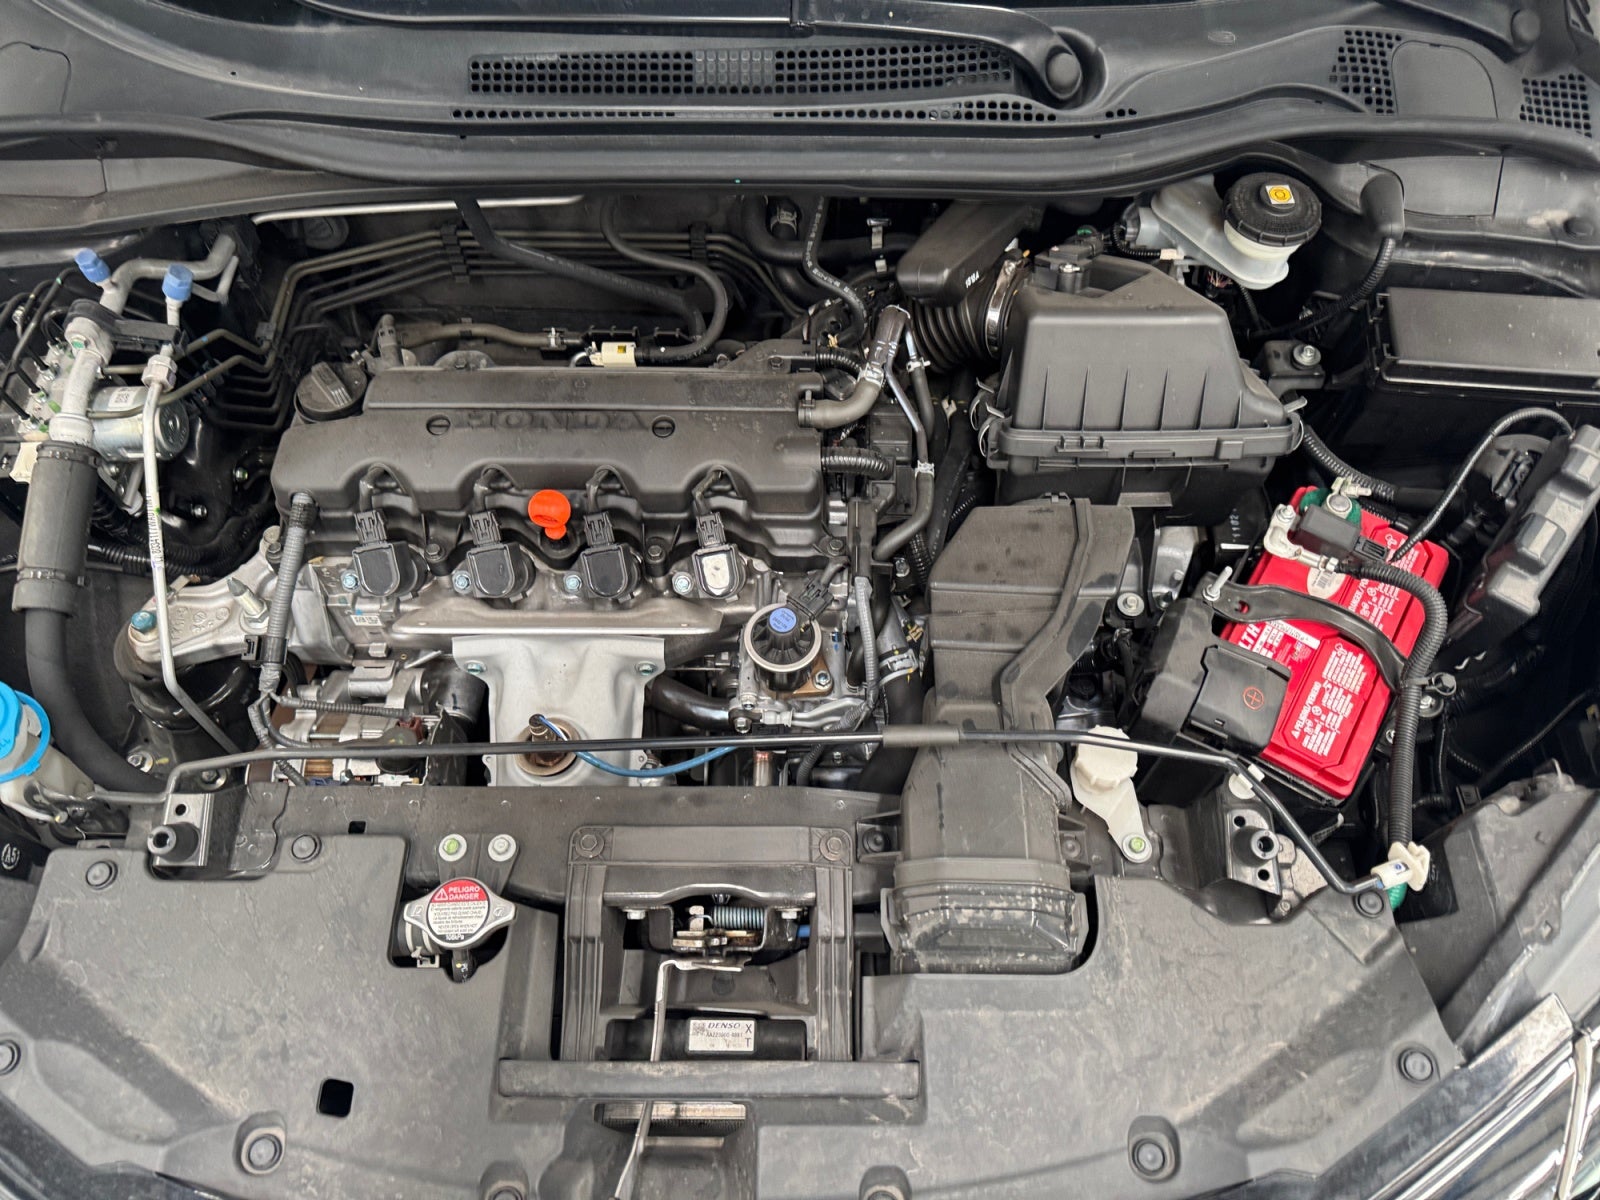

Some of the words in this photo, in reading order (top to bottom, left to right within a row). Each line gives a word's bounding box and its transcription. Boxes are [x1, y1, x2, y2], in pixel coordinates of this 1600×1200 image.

[453, 409, 649, 431] HONDA
[745, 1023, 752, 1034] X
[744, 1037, 752, 1048] T
